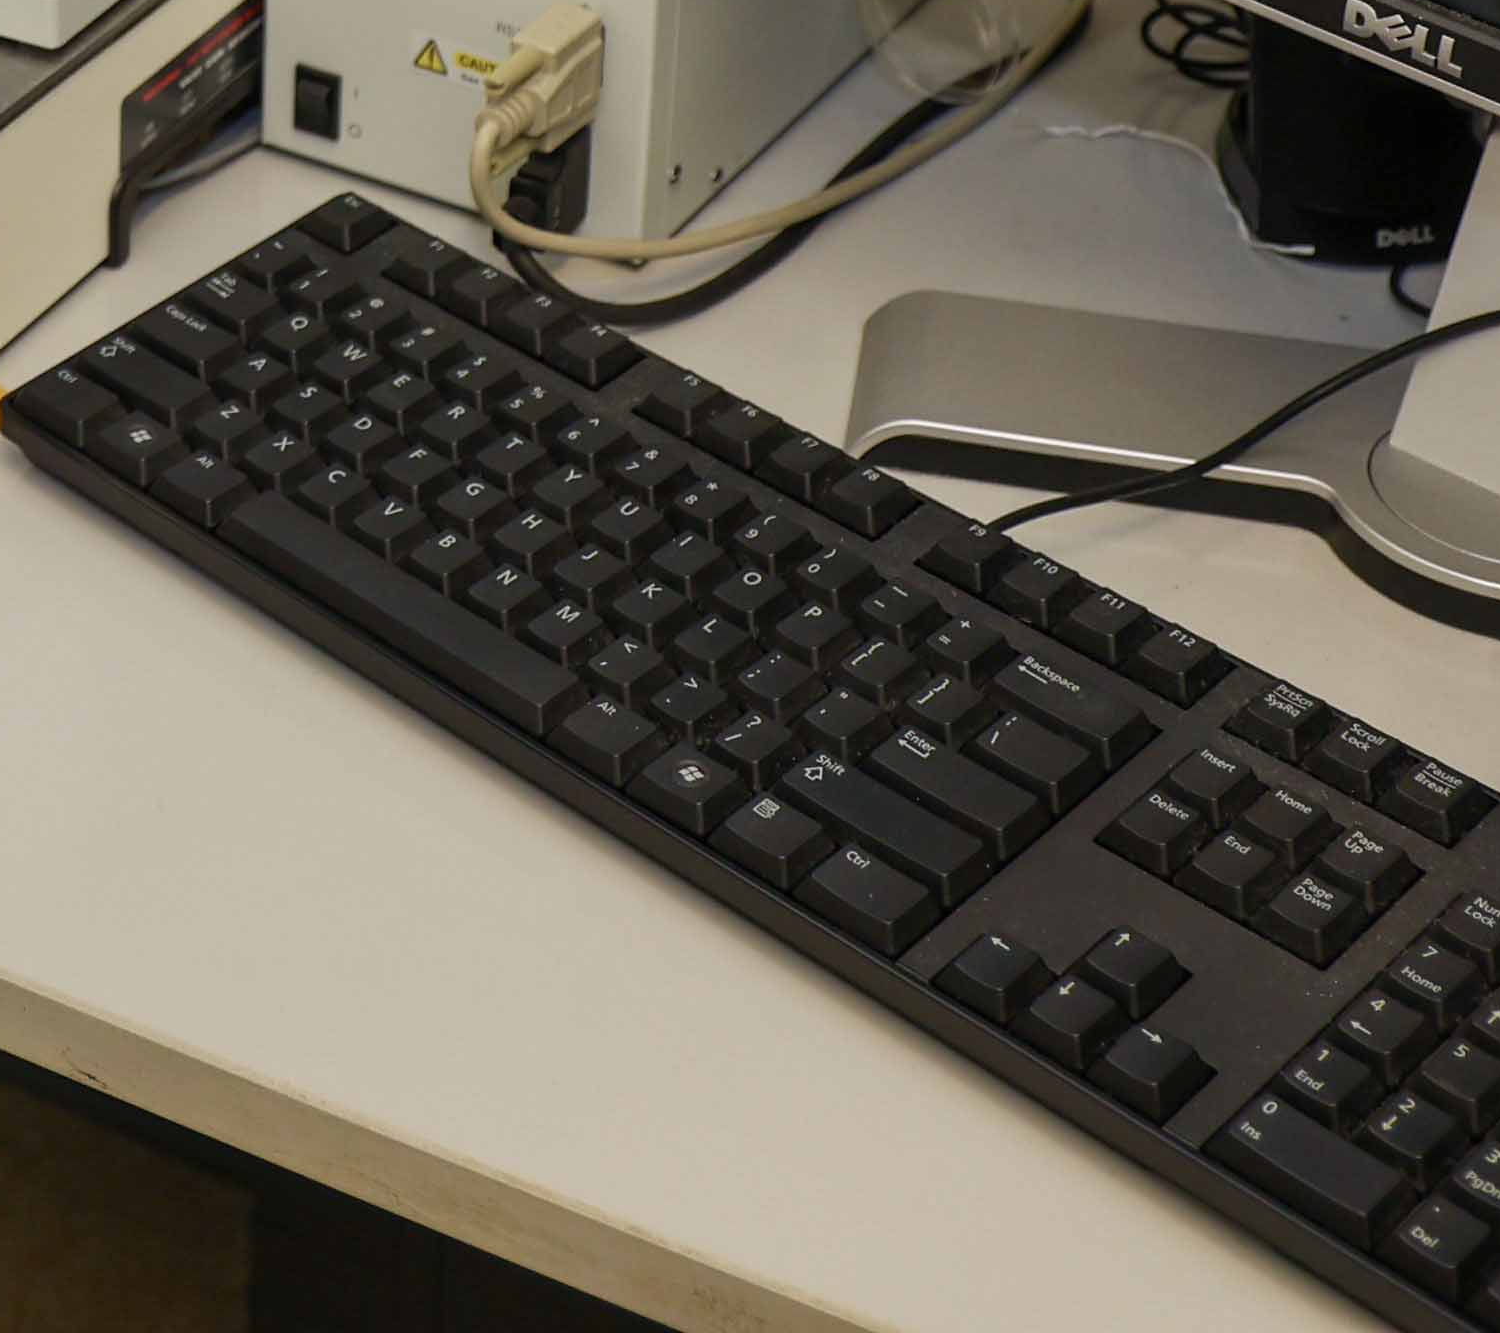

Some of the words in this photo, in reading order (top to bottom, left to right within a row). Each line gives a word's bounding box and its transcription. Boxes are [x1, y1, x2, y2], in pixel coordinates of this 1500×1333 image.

[1375, 226, 1435, 249] DELL
[290, 315, 309, 331] Q
[248, 356, 267, 372] A
[342, 344, 368, 362] W
[392, 373, 412, 388] E
[299, 385, 318, 399] S
[219, 404, 241, 420] Z
[272, 435, 295, 452] X
[327, 469, 347, 483] C
[968, 523, 988, 538] F9
[1032, 556, 1059, 575] F10
[1100, 592, 1127, 612] F11
[1168, 628, 1198, 649] F12
[1022, 655, 1081, 694] Backspace
[1263, 691, 1302, 719] SysRq
[1276, 683, 1315, 709] PrtScn
[597, 700, 618, 717] Alt
[903, 728, 937, 756] Enter
[1340, 730, 1372, 753] Lock
[1349, 722, 1387, 747] Scroll
[815, 753, 847, 777] Shift
[1200, 748, 1237, 774] Insert
[1414, 770, 1452, 798] Break
[1425, 761, 1464, 787] Pause
[1148, 792, 1191, 822] Delete
[1274, 788, 1313, 816] Home
[1223, 833, 1251, 855] End
[1343, 836, 1364, 856] Up
[1351, 829, 1385, 855] Page
[844, 849, 872, 870] Ctrl
[1292, 882, 1334, 913] Down
[1303, 876, 1336, 903] Page
[1463, 903, 1496, 930] Lock
[1421, 945, 1440, 960] 7
[1400, 964, 1444, 995] Home
[1369, 997, 1387, 1013] 4
[1316, 1047, 1331, 1063] 1
[1452, 1043, 1469, 1059] 5
[1294, 1068, 1326, 1093] End
[1262, 1100, 1278, 1116] 0
[1399, 1097, 1417, 1115] 2
[1239, 1120, 1262, 1142] Ins
[1410, 1224, 1440, 1250] Del
